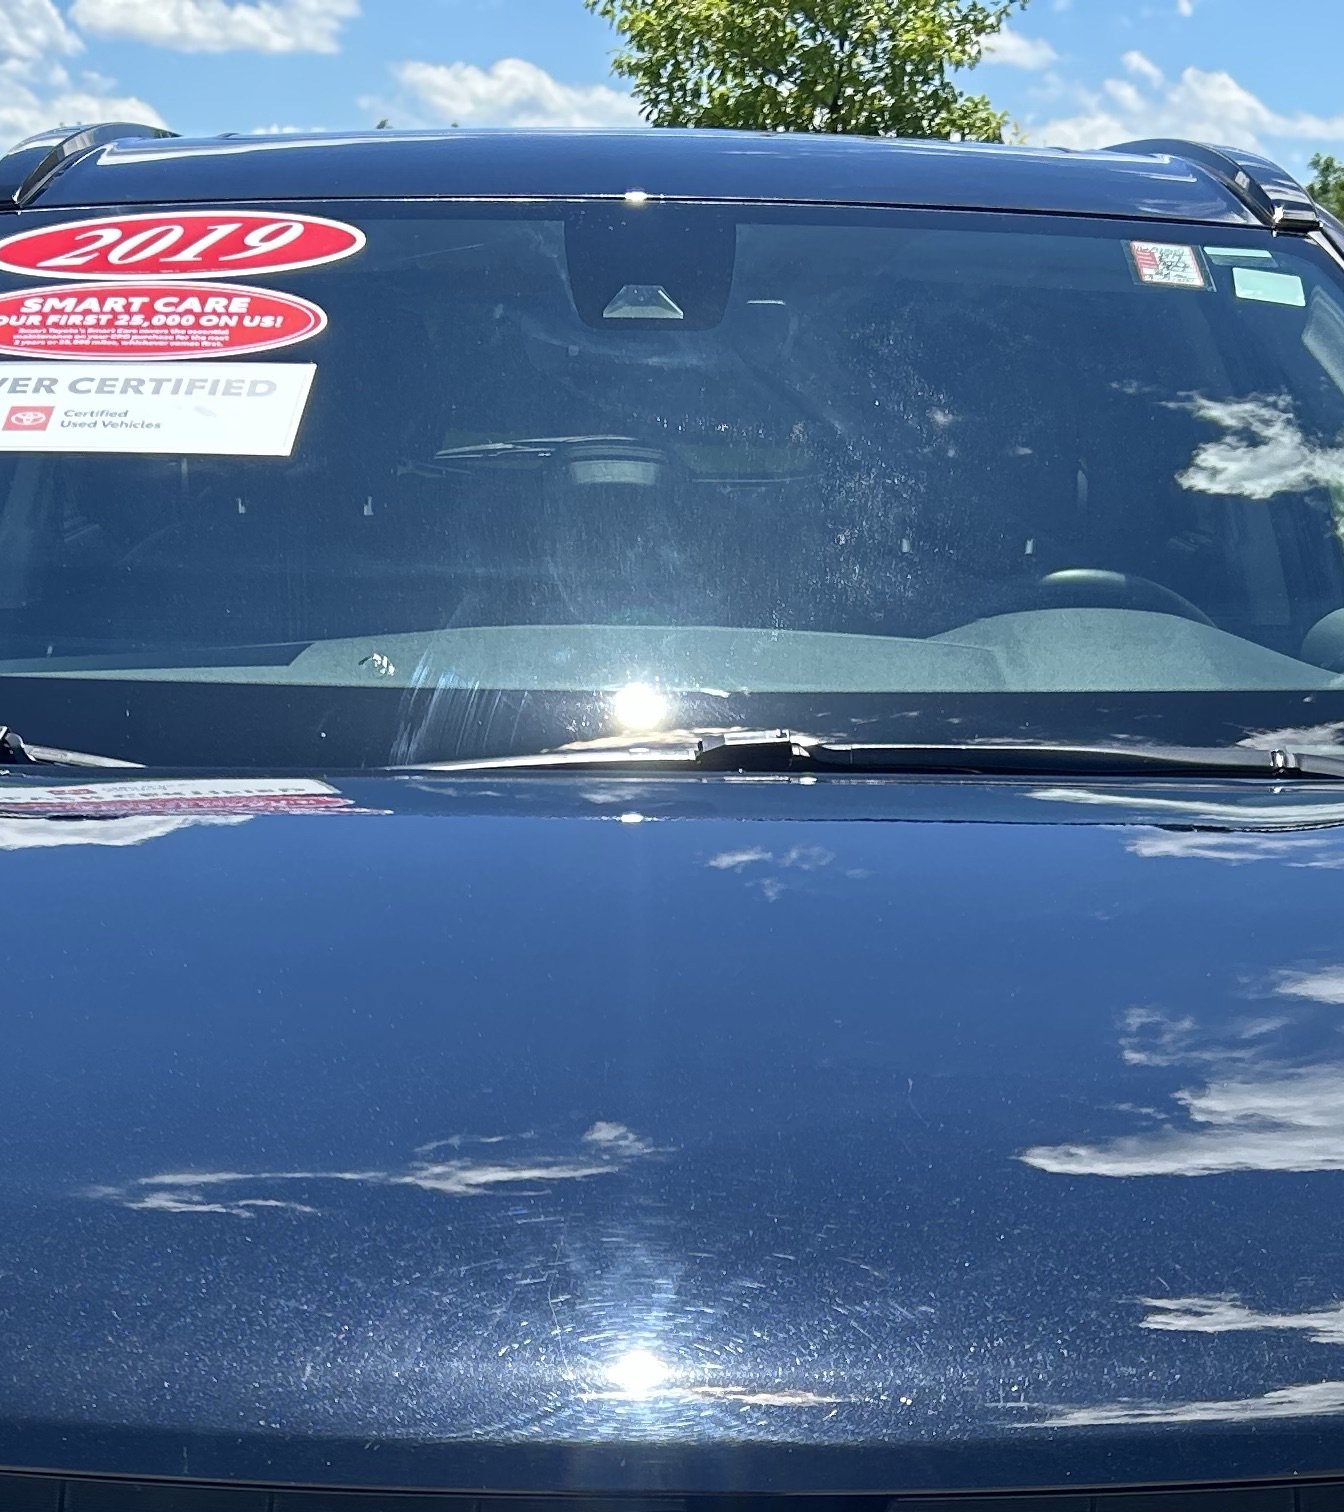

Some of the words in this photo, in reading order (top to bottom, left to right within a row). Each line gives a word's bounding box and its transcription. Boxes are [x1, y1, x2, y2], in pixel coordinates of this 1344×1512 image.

[36, 221, 305, 268] 2019
[20, 297, 150, 314] SMART
[152, 297, 251, 314] CARE
[46, 314, 112, 327] FIRST
[115, 314, 197, 329] 25,000
[199, 314, 239, 328] ON
[242, 315, 284, 328] US!
[67, 377, 278, 398] CERTIFIED
[63, 409, 128, 418] Certified
[60, 420, 97, 429] Used
[101, 420, 162, 430] Vehicles
